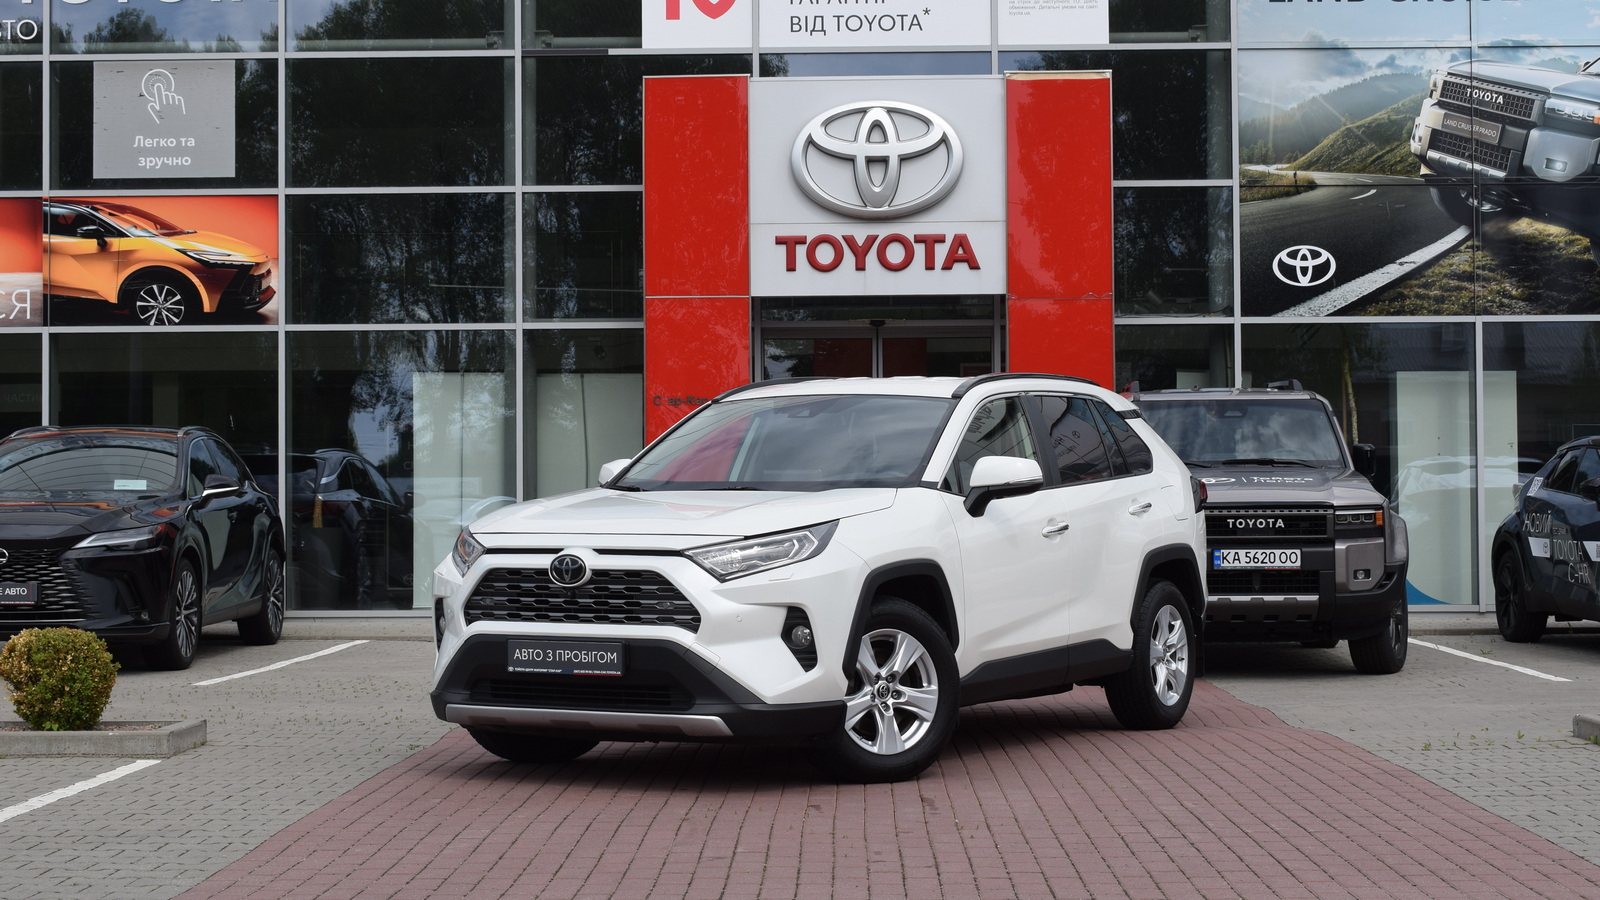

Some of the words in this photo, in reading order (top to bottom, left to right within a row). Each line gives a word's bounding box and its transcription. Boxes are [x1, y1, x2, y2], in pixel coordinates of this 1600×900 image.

[0, 19, 38, 40] ТО
[790, 15, 827, 36] ВІД
[1466, 88, 1504, 105] TOYOTA
[1443, 118, 1458, 127] LAND
[1457, 121, 1479, 132] CRUISER
[1479, 126, 1497, 137] PRADO
[133, 135, 177, 148] Легко
[180, 137, 195, 147] та
[138, 156, 191, 169] зручно
[775, 233, 981, 272] TOYOTA
[1226, 518, 1285, 529] TOYOTA
[1522, 509, 1552, 534] НОВИЙ
[1221, 551, 1241, 564] KA
[1245, 551, 1276, 564] 5620
[1553, 539, 1584, 561] TOYOTA
[1568, 562, 1591, 584] C-HR
[4, 587, 27, 595] АВТО
[513, 648, 543, 661] АВТО
[556, 650, 617, 664] ПРОБІГОМ
